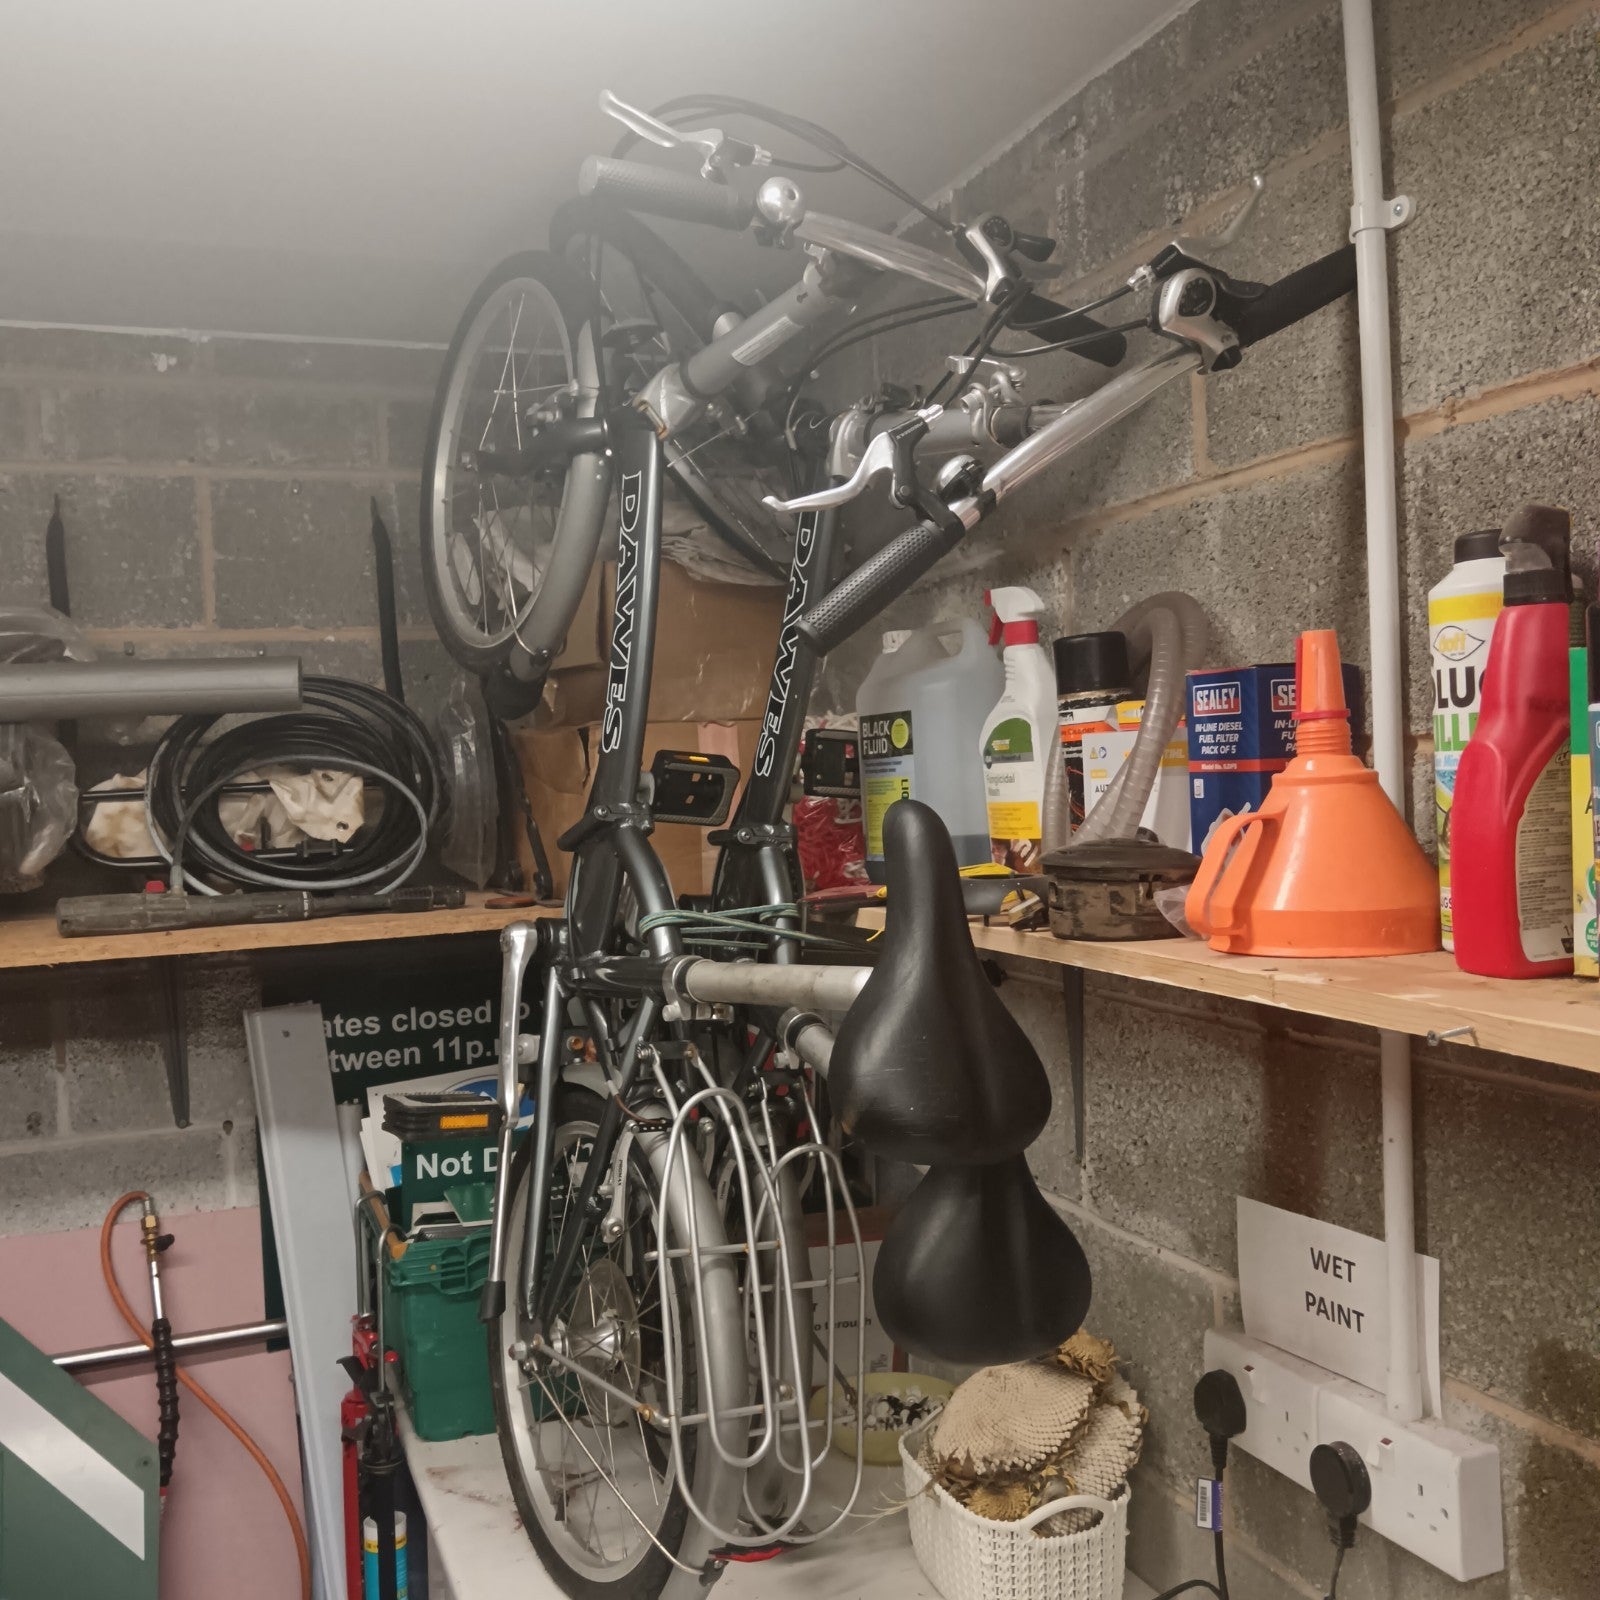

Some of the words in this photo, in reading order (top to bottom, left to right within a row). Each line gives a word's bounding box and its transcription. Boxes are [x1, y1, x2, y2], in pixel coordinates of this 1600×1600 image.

[602, 469, 642, 753] DAWES
[755, 510, 819, 777] DAWES
[1196, 687, 1236, 711] SEALEY
[862, 720, 891, 738] BLACK
[1195, 722, 1217, 733] IN-LINE
[1218, 721, 1243, 732] DIESEL
[1199, 735, 1215, 744] FUEL
[1215, 733, 1240, 743] FILTER
[862, 738, 888, 755] FLUID
[1201, 745, 1219, 755] PACK
[1220, 745, 1230, 754] OF
[1231, 744, 1237, 754] 5
[322, 1014, 380, 1038] ates
[391, 1000, 492, 1033] closed
[329, 1044, 420, 1073] tween
[432, 1035, 501, 1065] 11p.
[416, 1153, 473, 1180] Not
[1310, 1247, 1356, 1283] WET
[825, 1317, 872, 1330] trouh
[1305, 1290, 1365, 1333] PAINT
